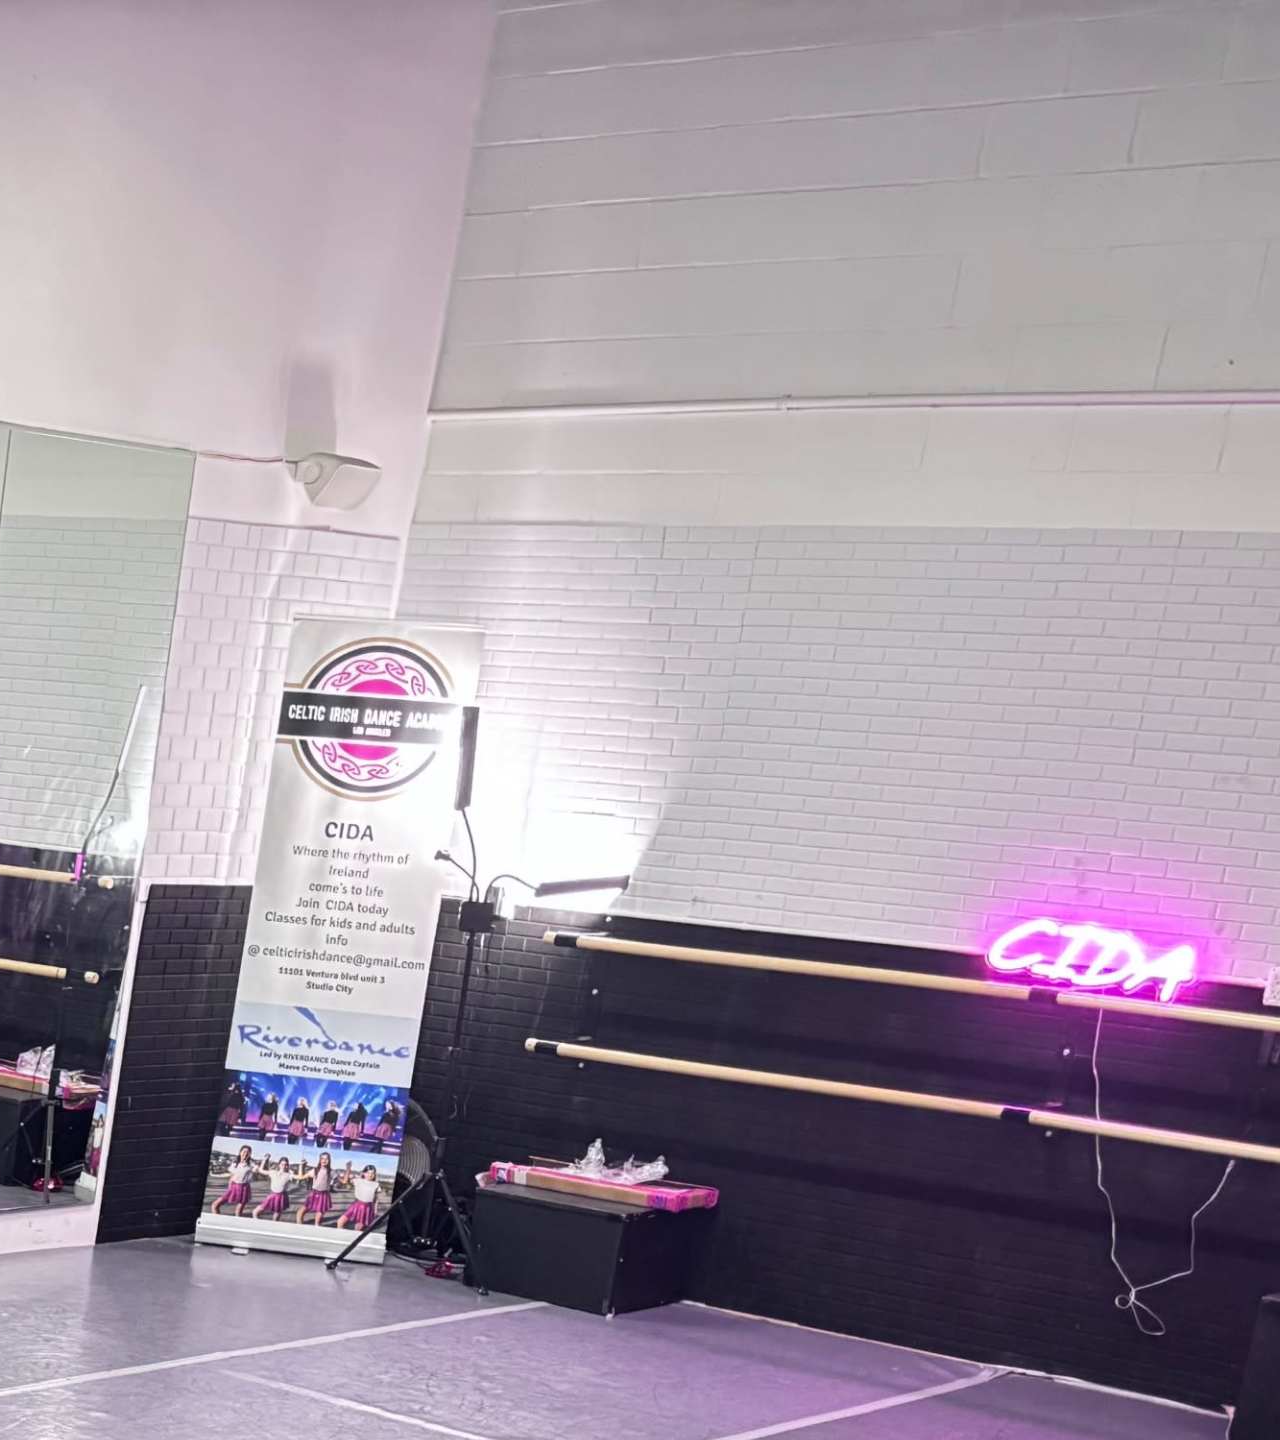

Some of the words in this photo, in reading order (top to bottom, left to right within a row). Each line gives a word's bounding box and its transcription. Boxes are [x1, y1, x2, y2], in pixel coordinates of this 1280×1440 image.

[288, 704, 326, 721] CELTIC
[329, 706, 359, 724] IRISH
[363, 708, 402, 728] DANCE
[324, 821, 374, 841] CIDA
[292, 845, 329, 858] Where
[331, 848, 350, 860] the
[352, 850, 394, 865] rhythm
[397, 853, 410, 865] of
[328, 865, 370, 879] Ireland
[308, 882, 348, 894] come's
[351, 885, 363, 896] to
[365, 886, 384, 898] life
[295, 897, 320, 910] Join
[325, 899, 355, 913] CIDA
[357, 903, 389, 918] today
[264, 911, 308, 926] Classes
[310, 914, 327, 927] for
[329, 916, 352, 930] kids
[355, 919, 376, 932] and
[379, 922, 416, 935] adults
[325, 933, 348, 946] info
[247, 944, 261, 957] @
[262, 945, 426, 971] celticirishdance@gmail.com
[988, 918, 1196, 1004] CIDA
[305, 968, 339, 980] Ventura
[340, 971, 358, 981] blvd
[360, 974, 377, 984] unit
[305, 980, 334, 991] Studio
[335, 983, 354, 995] City
[238, 1006, 411, 1059] Riverdance
[273, 1051, 282, 1061] by
